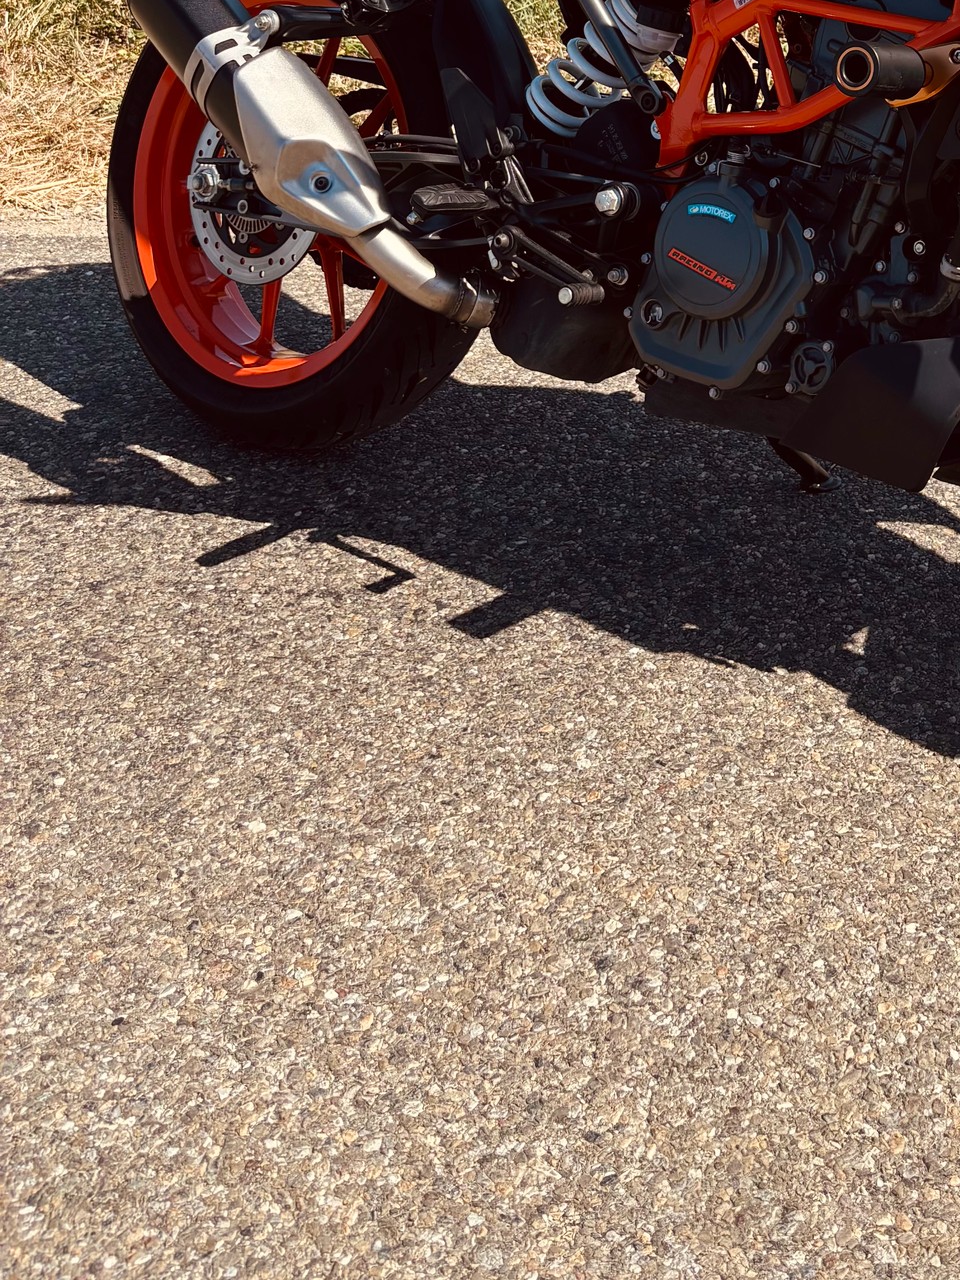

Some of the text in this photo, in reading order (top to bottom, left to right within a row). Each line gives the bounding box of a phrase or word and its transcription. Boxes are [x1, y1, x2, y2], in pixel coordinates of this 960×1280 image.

[699, 205, 733, 222] MOTOREX
[671, 250, 737, 291] RACING KTM
